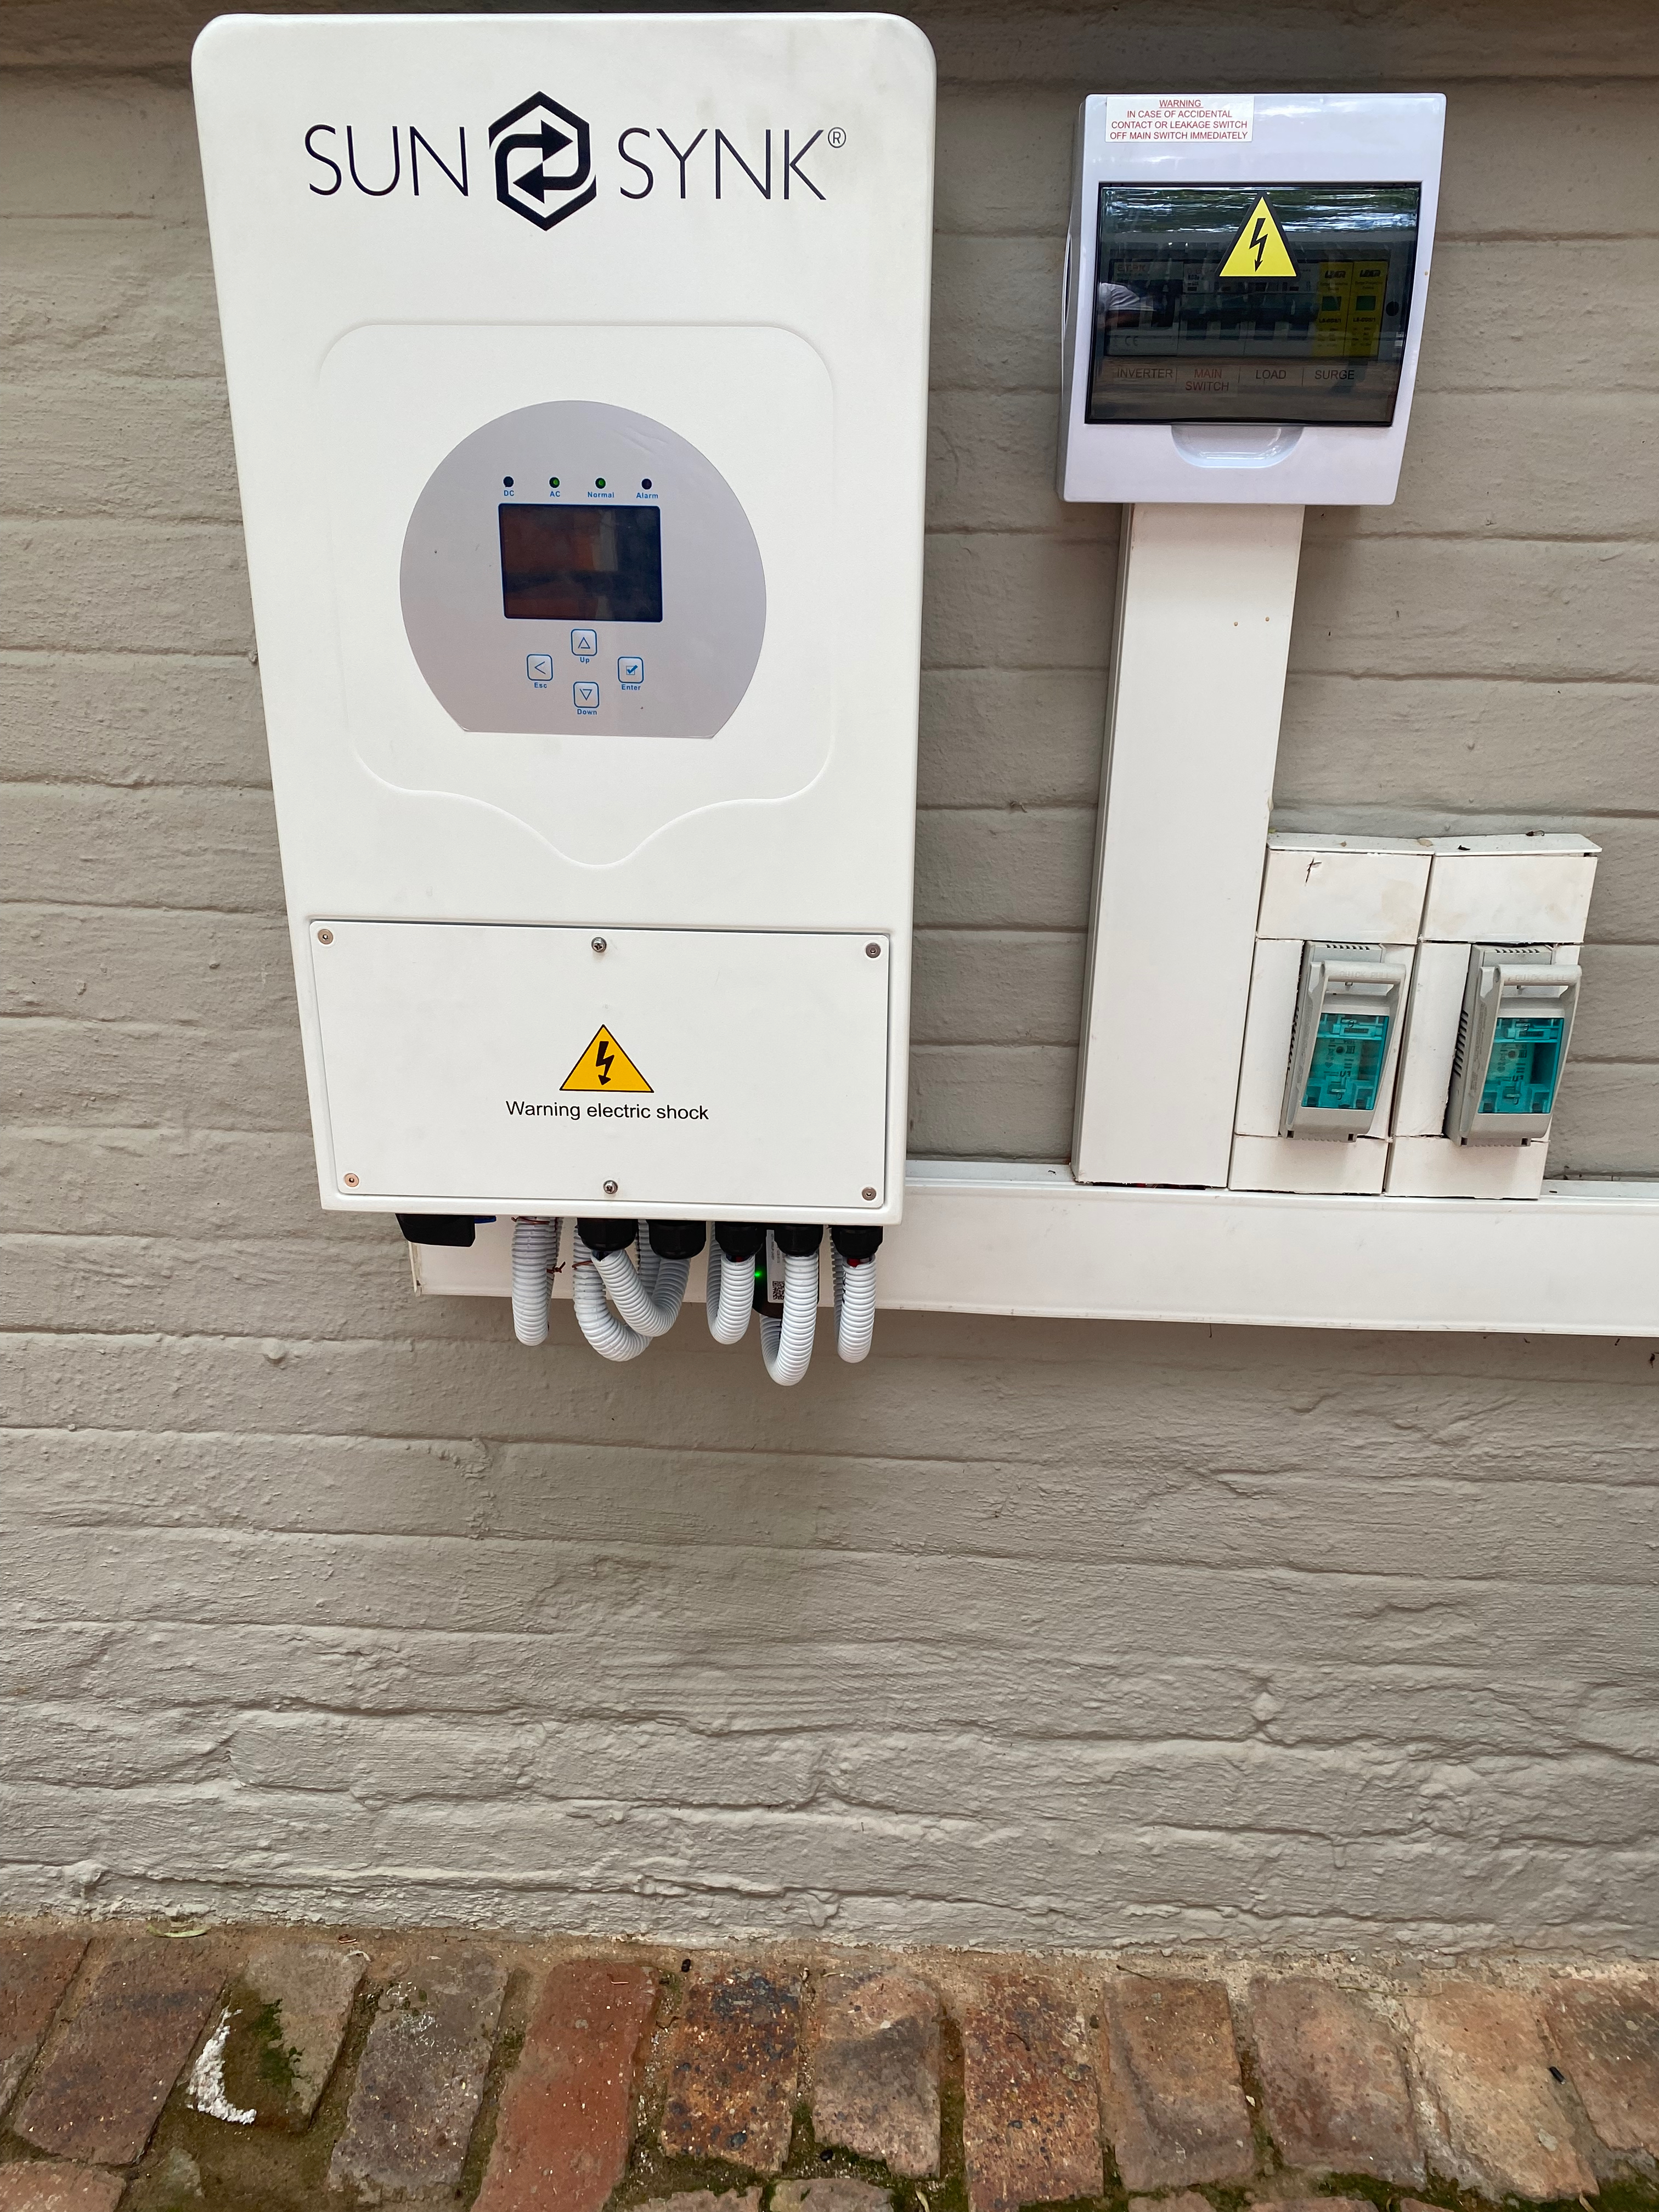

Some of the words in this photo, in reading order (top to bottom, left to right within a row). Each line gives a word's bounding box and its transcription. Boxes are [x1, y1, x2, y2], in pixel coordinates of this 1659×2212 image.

[1159, 99, 1201, 108] WARNING
[1178, 110, 1233, 118] ACCIDENTAL
[1111, 121, 1153, 129] CONTACT
[1154, 121, 1168, 129] OR
[1170, 121, 1211, 129] LEAKAGE
[1110, 132, 1127, 140] OFF
[1129, 132, 1152, 140] MAIN
[1153, 132, 1188, 140] SWITCH
[1190, 132, 1248, 140] IMMEDIATELY
[304, 124, 469, 198] SUN
[1116, 367, 1173, 379] INVERTER
[1193, 368, 1222, 379] MAIN
[1255, 369, 1287, 380] LOAD
[1314, 370, 1355, 380] SURGE
[1185, 381, 1229, 392] SWITCH
[505, 1101, 580, 1120] Warning
[586, 1103, 651, 1119] electric
[656, 1104, 709, 1120] shock
